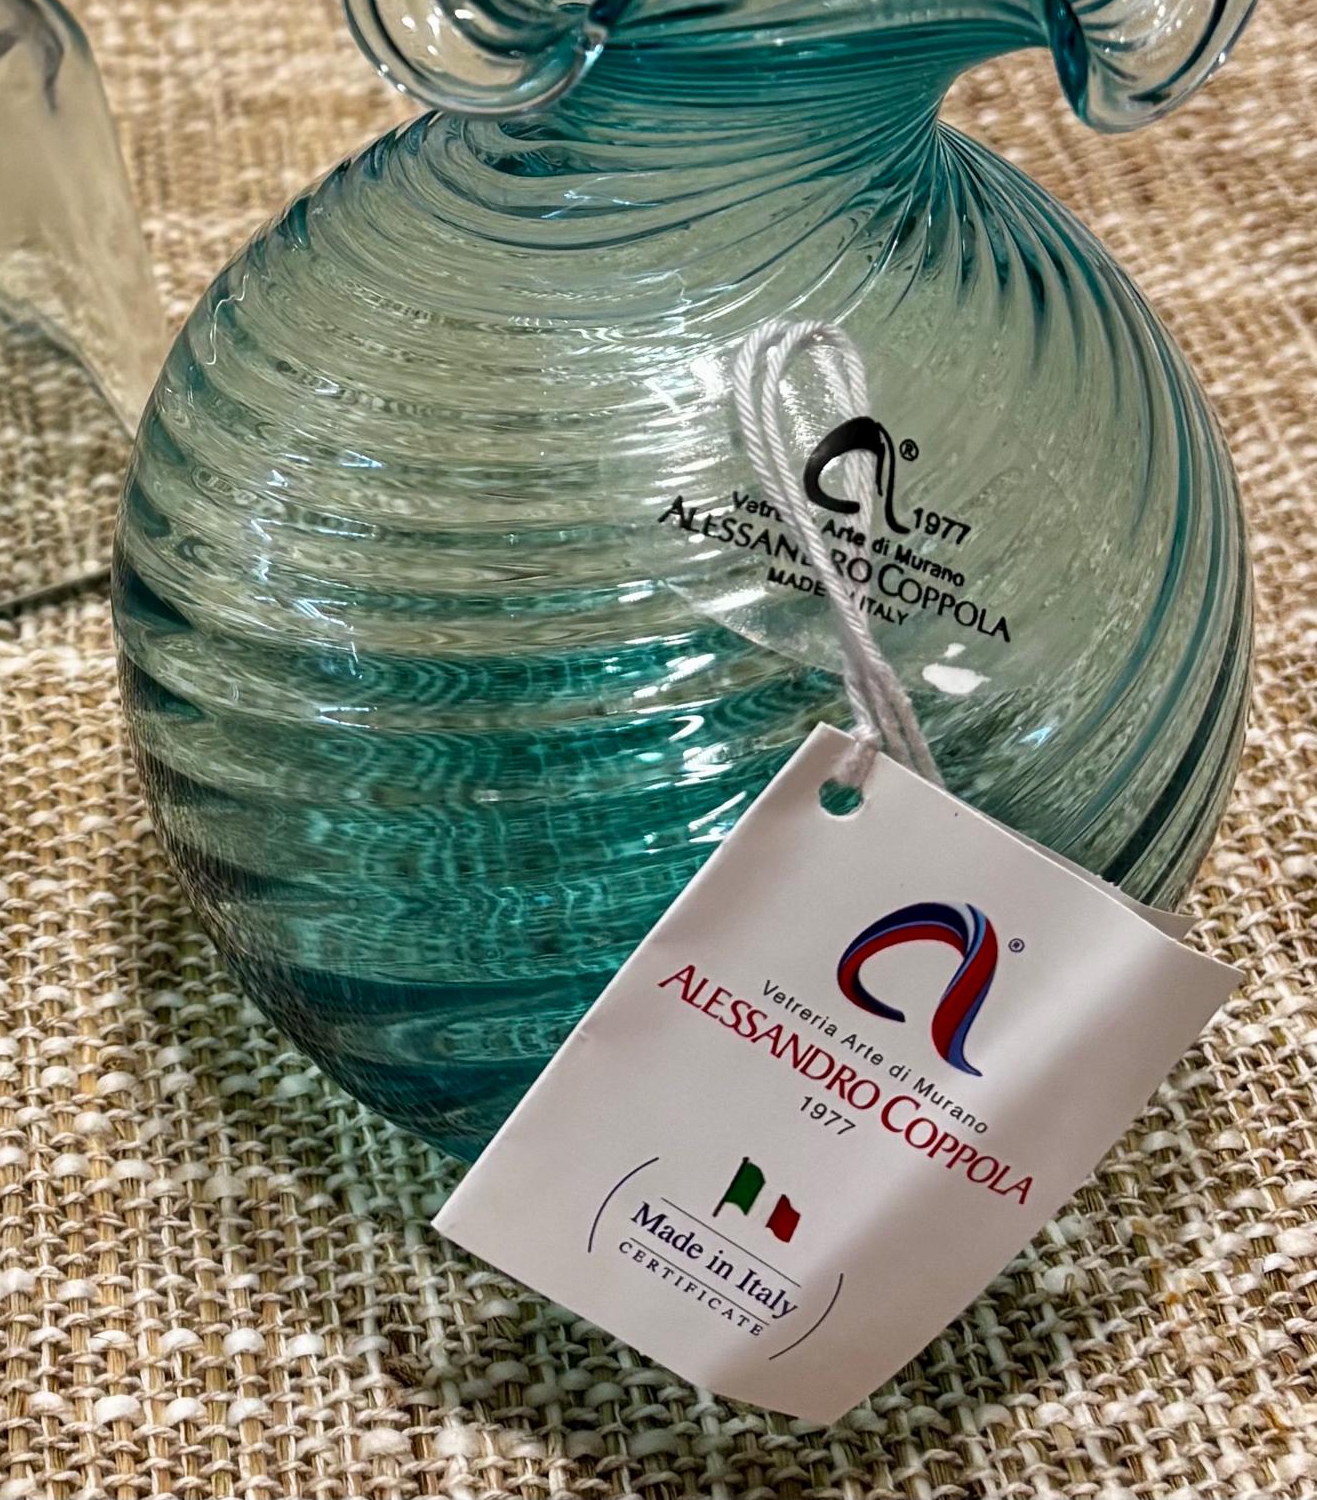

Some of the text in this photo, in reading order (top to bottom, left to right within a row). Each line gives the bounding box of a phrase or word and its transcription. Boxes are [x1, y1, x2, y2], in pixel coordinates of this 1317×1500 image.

[821, 518, 866, 546] Arte
[871, 537, 890, 556] di
[894, 544, 965, 587] Murano
[913, 507, 972, 545] 1977
[766, 566, 827, 598] MADE
[859, 596, 909, 626] ITALY
[877, 563, 1011, 643] COPPOLA
[657, 964, 1034, 1205] ALESSANDRO COPPOLA
[762, 979, 989, 1135] Vetreria Arte di Murano
[799, 1095, 856, 1137] 1977
[618, 1240, 765, 1337] CERTIFICATE
[630, 1201, 799, 1319] Made in Italy
